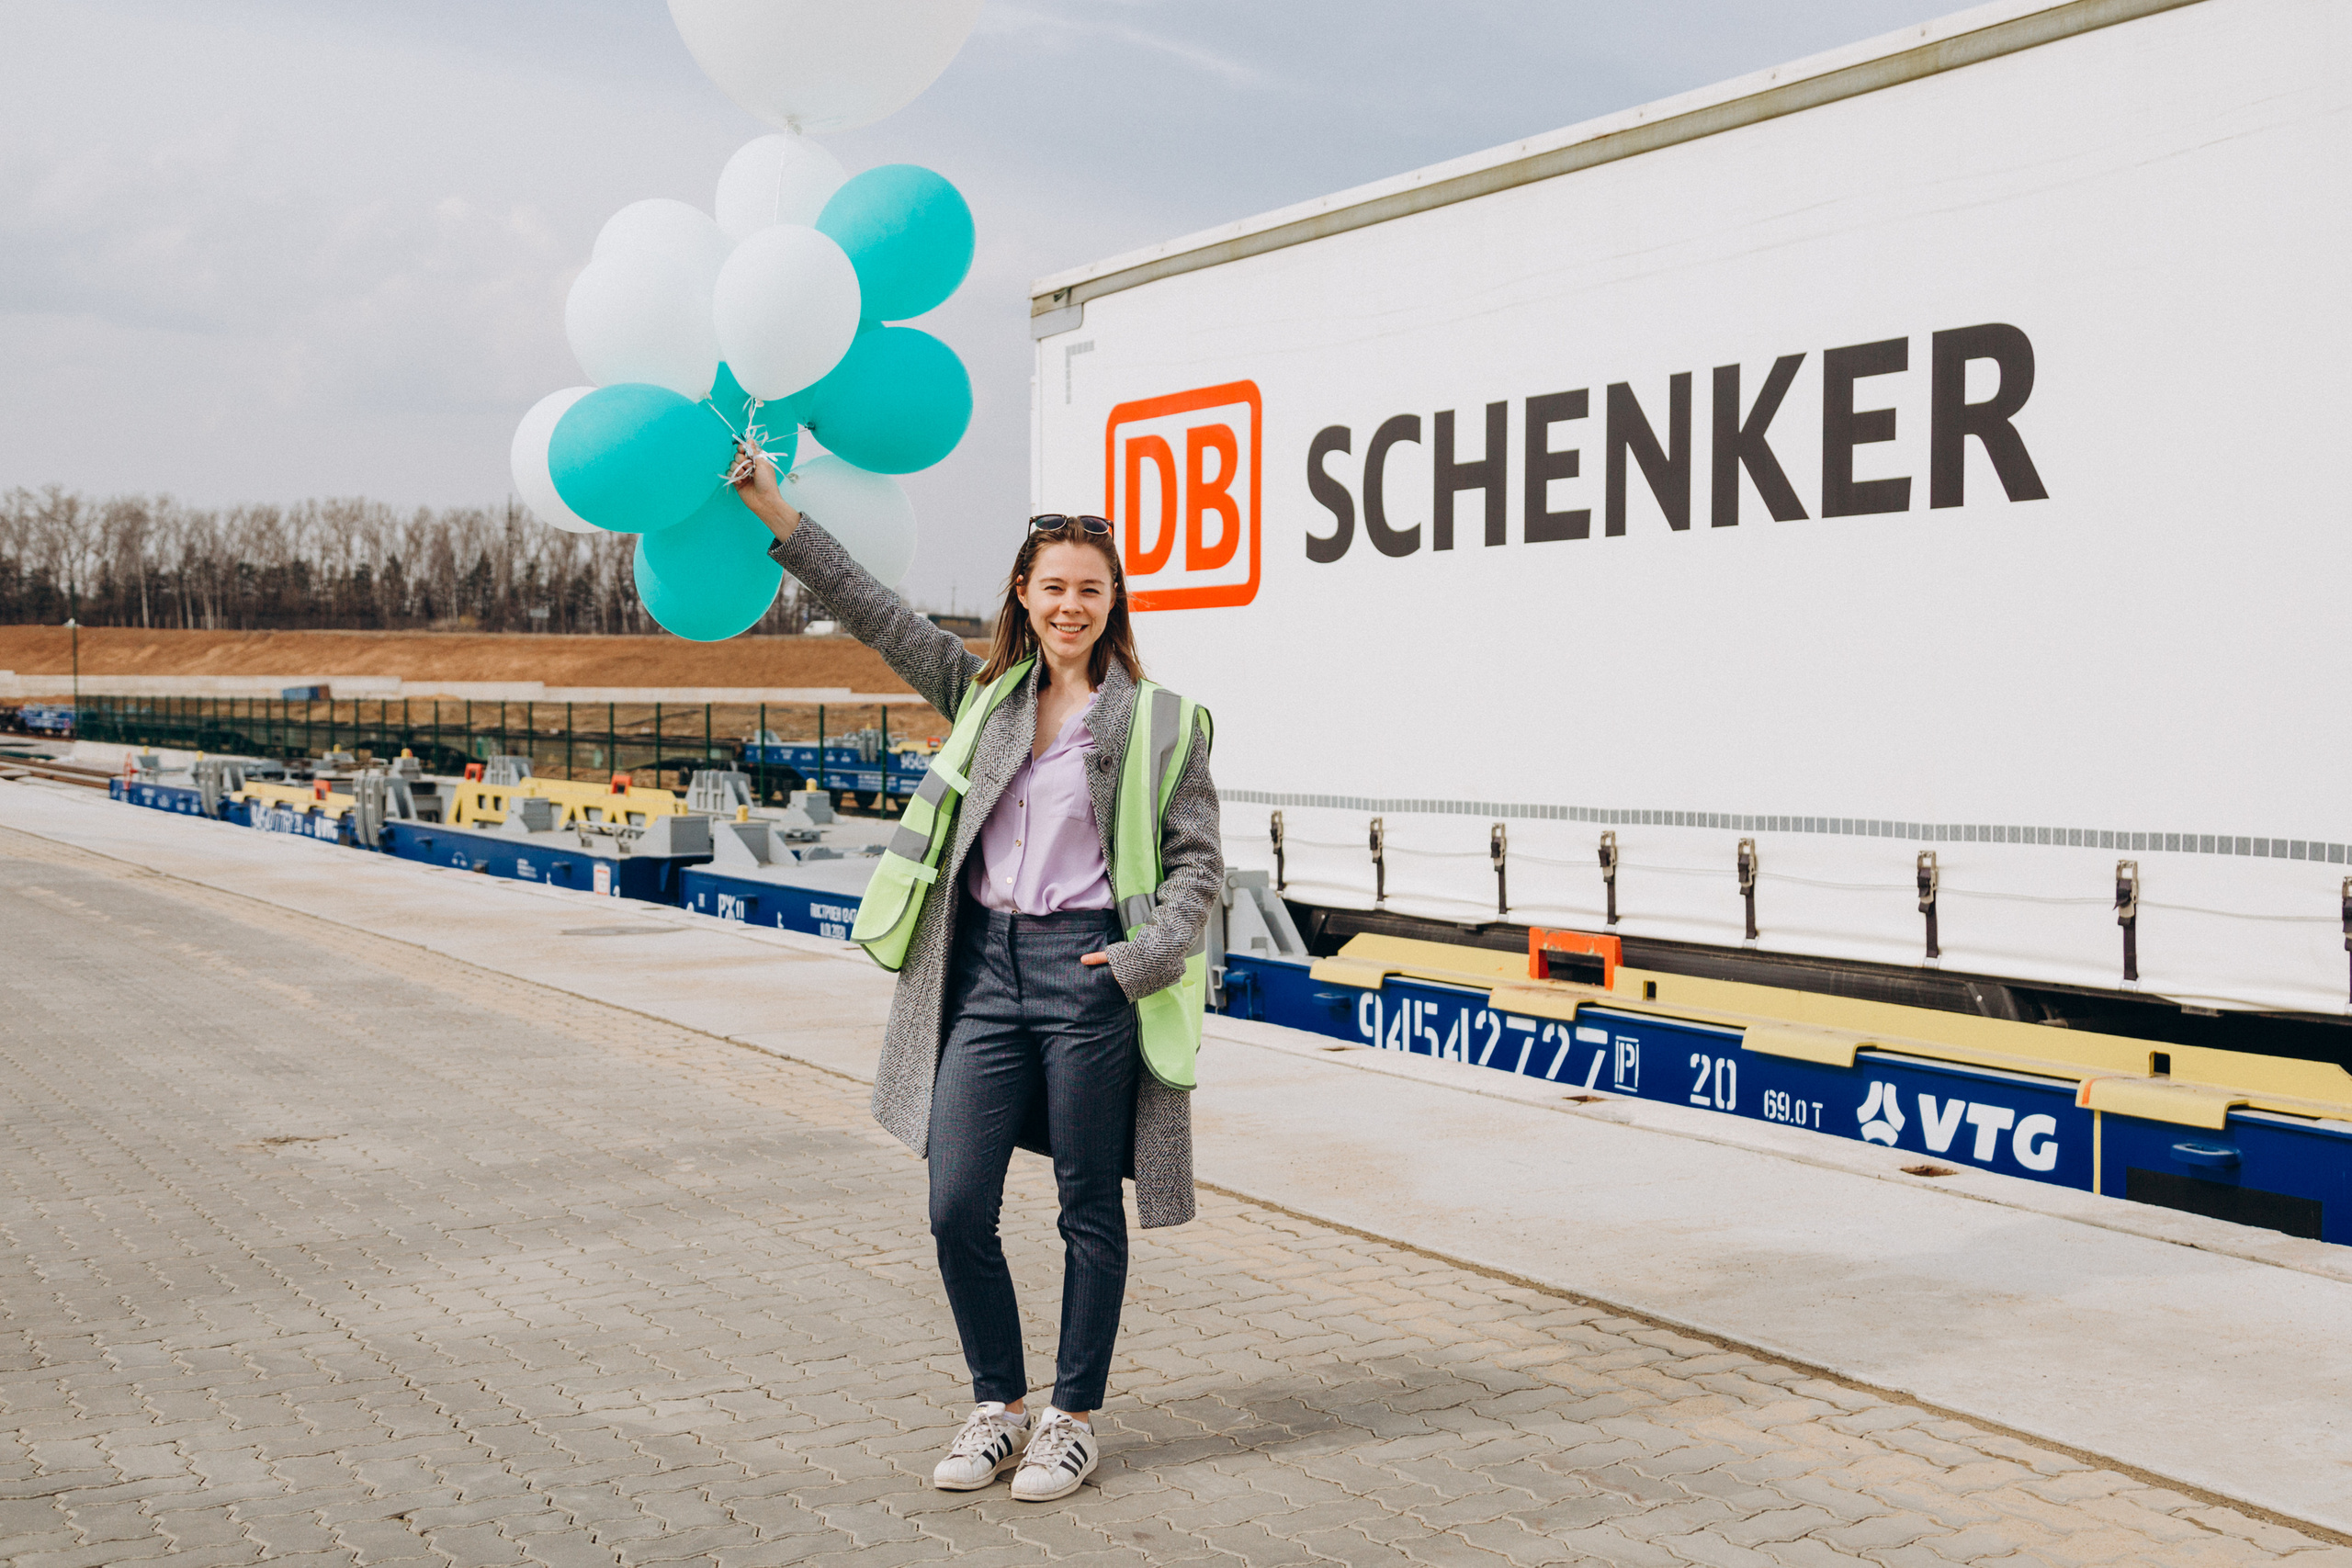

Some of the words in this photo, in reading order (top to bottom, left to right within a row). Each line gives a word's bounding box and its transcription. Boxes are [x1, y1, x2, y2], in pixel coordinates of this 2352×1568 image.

[1125, 423, 1240, 576] DB
[1306, 323, 2049, 564] SCHENKER
[1359, 992, 1608, 1089] 94542727
[1690, 1054, 1736, 1111] 20
[1764, 1089, 1807, 1125] 69.0
[1813, 1102, 1824, 1128] T
[1918, 1093, 2058, 1171] VTG
